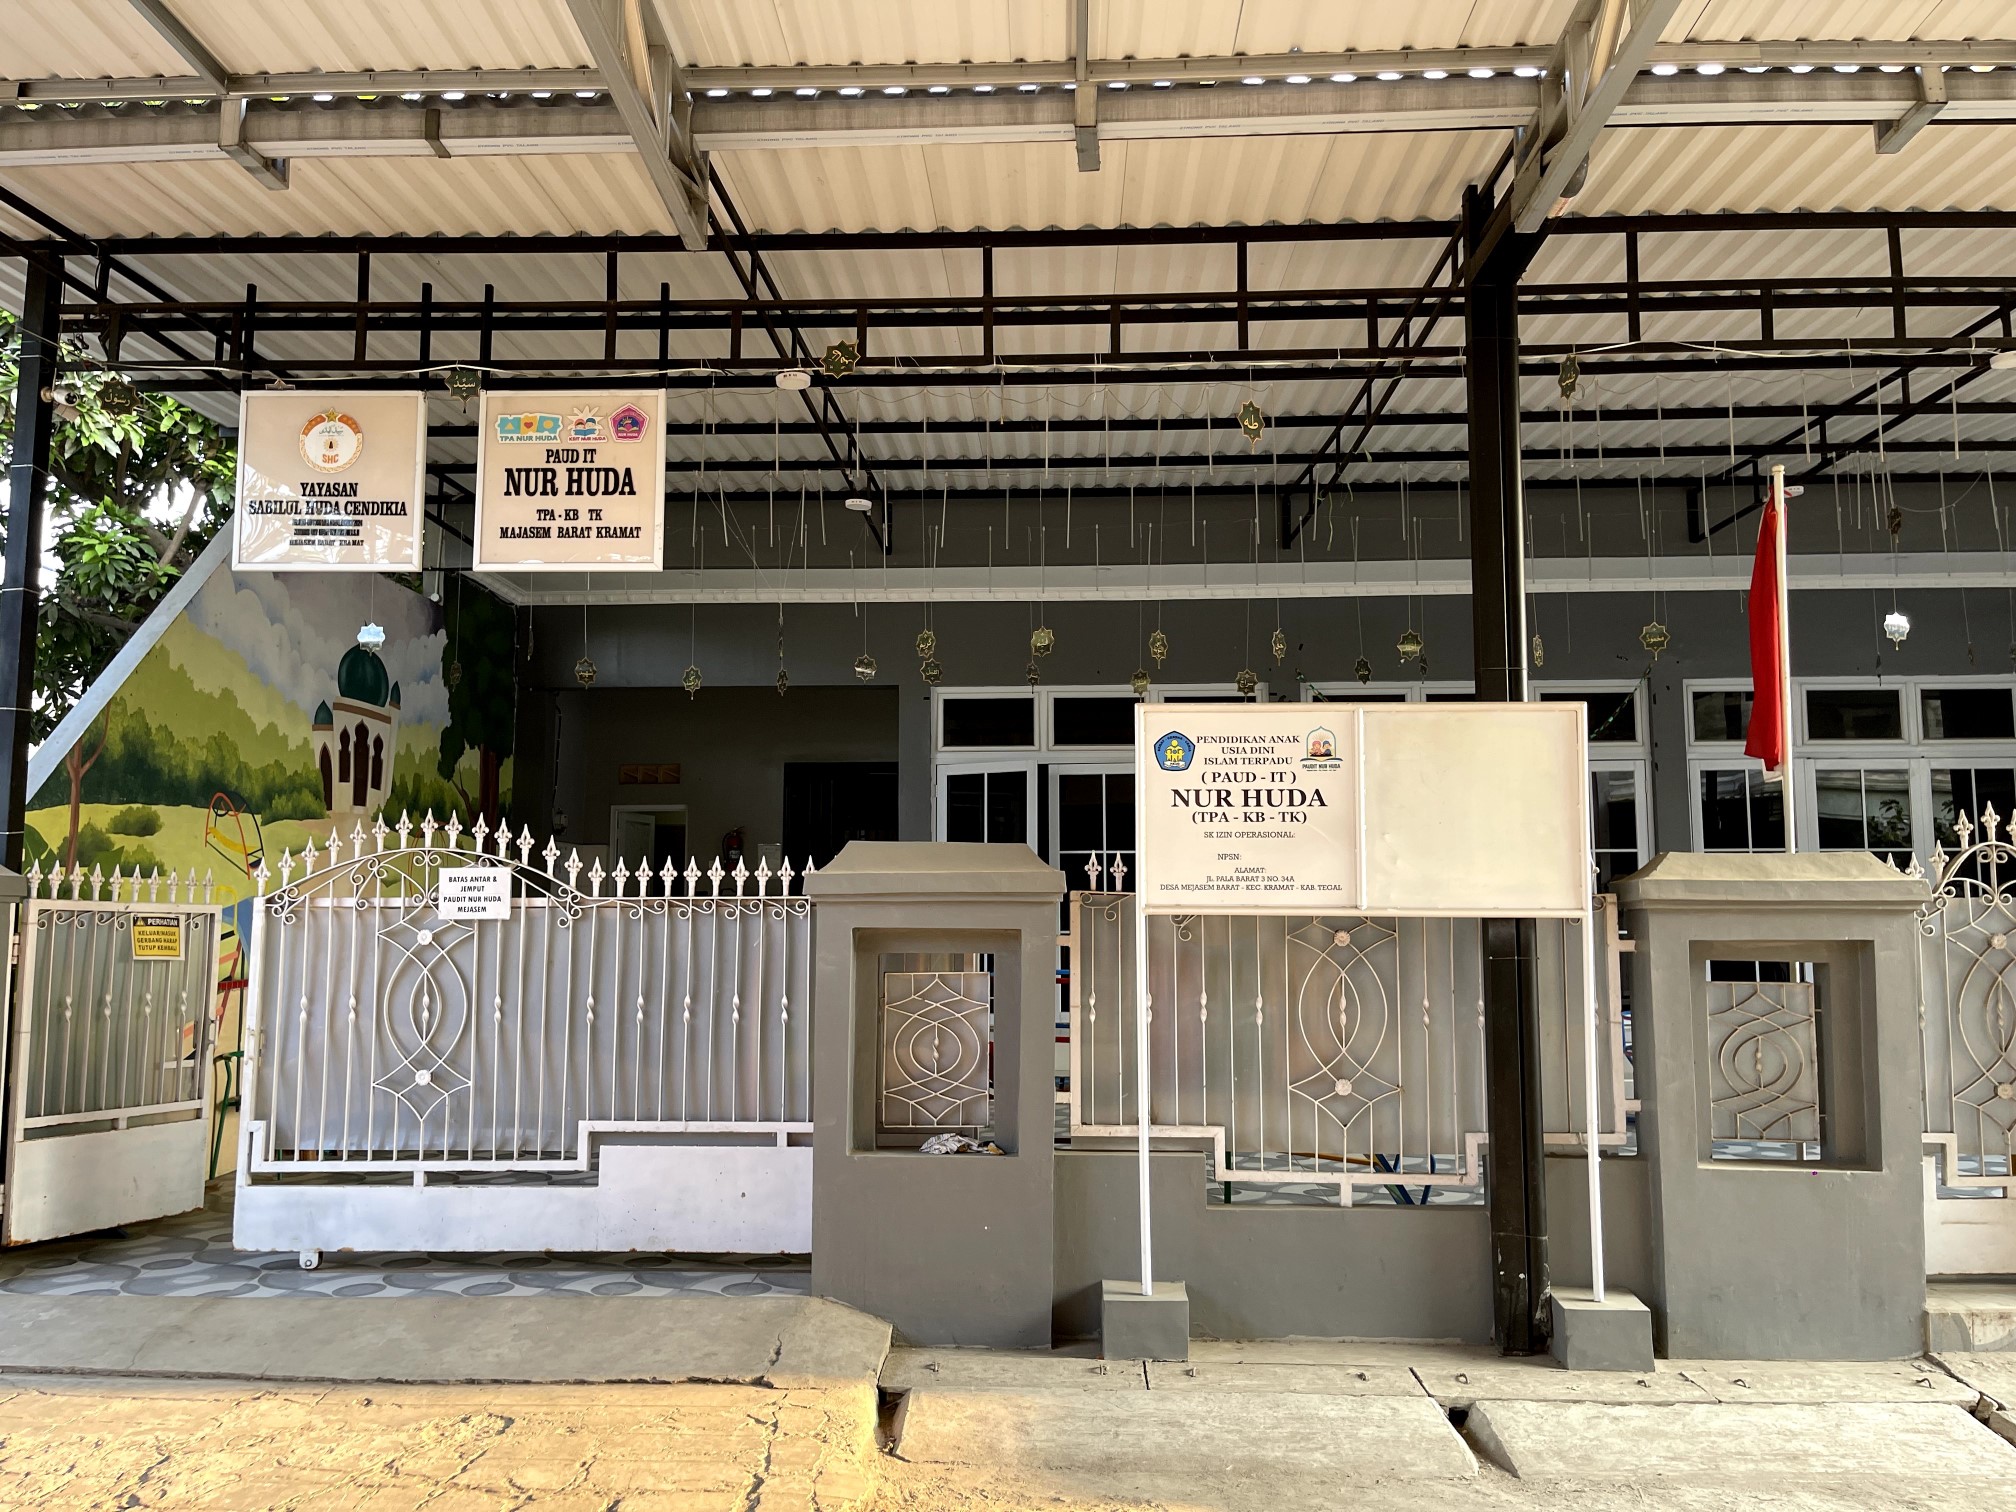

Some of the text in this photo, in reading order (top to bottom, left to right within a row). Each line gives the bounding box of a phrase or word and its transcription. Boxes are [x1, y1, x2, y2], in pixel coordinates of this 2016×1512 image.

[322, 454, 338, 464] SHC
[545, 449, 596, 464] PAUD IT
[504, 467, 636, 496] NUR HUDA
[300, 483, 358, 497] YAYASAN
[249, 500, 407, 516] SABILUL HUDA CENDIKIA
[536, 509, 556, 520] TPA
[564, 509, 579, 520] KB
[588, 509, 602, 520] TK
[500, 527, 641, 538] MAJASEM BARAT KRAMAT
[1197, 736, 1265, 744] PENDIDIKAN
[1204, 757, 1293, 765] ISLAM TERPADU
[1171, 789, 1328, 808] NUR HUDA
[1243, 812, 1265, 822] KB
